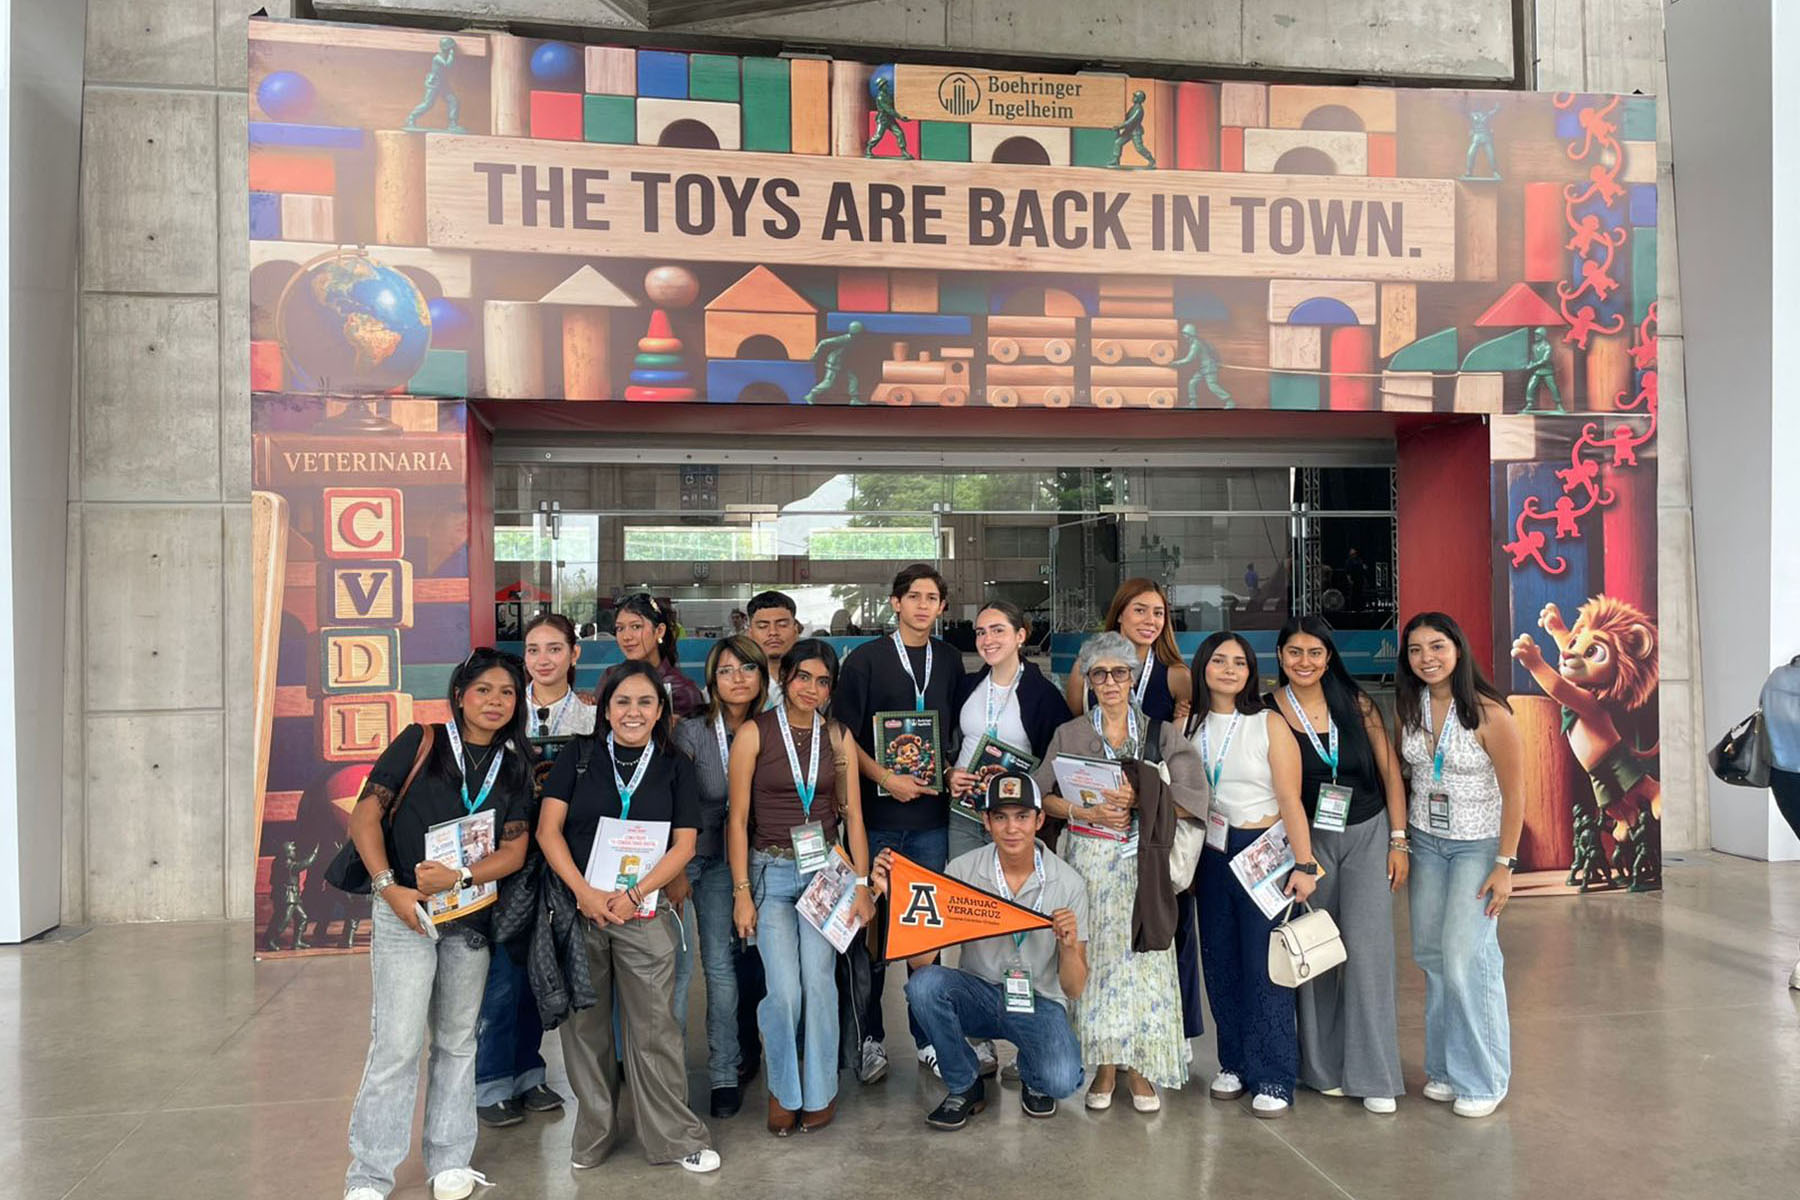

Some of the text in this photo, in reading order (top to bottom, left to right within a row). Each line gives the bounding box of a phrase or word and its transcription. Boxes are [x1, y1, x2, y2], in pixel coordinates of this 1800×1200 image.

[988, 75, 1083, 98] Boehringer
[988, 98, 1074, 120] Ingelheim
[474, 162, 1422, 258] THE TOYS ARE BACK IN TOWN.
[283, 451, 454, 473] VETERINARIA
[901, 884, 943, 926] A
[947, 905, 1001, 919] VERACRUZ
[948, 895, 999, 909] ANAHUAC
